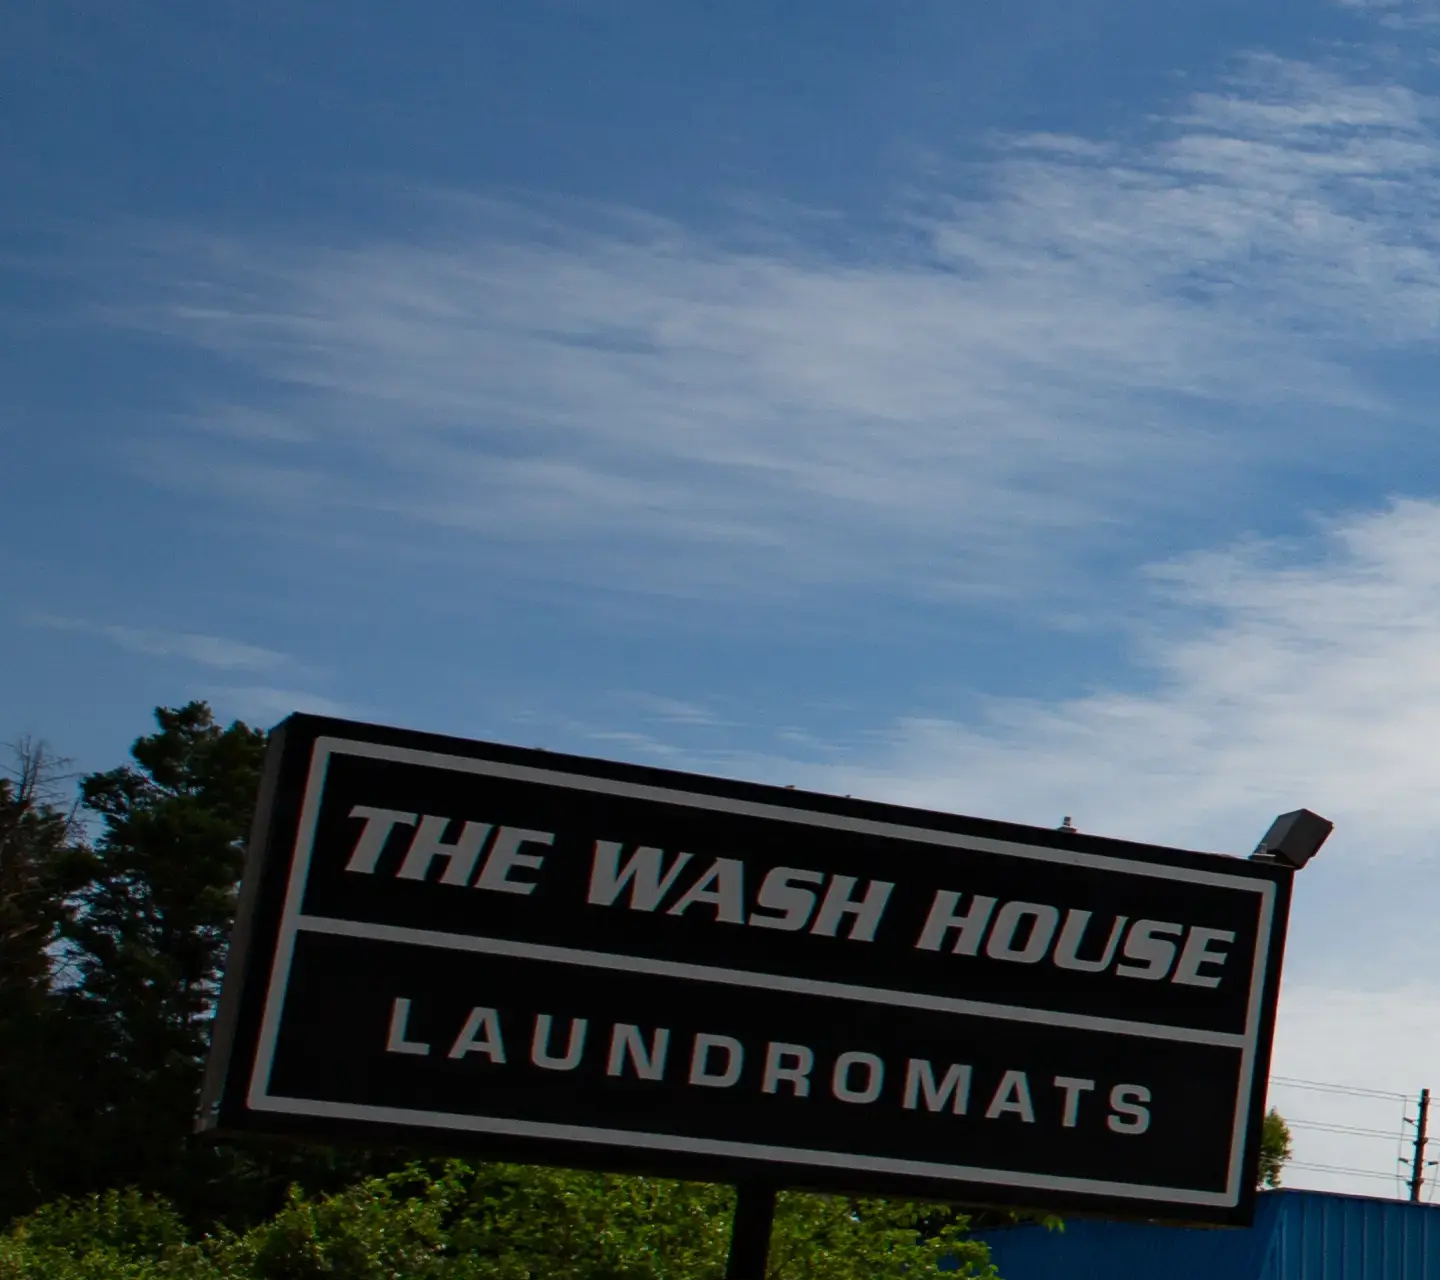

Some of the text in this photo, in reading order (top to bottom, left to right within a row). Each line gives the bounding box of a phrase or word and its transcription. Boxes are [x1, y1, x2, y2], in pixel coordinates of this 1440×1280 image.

[345, 805, 1236, 988] THE WASH HOUSE
[386, 997, 1151, 1135] LAUNDROMATS
